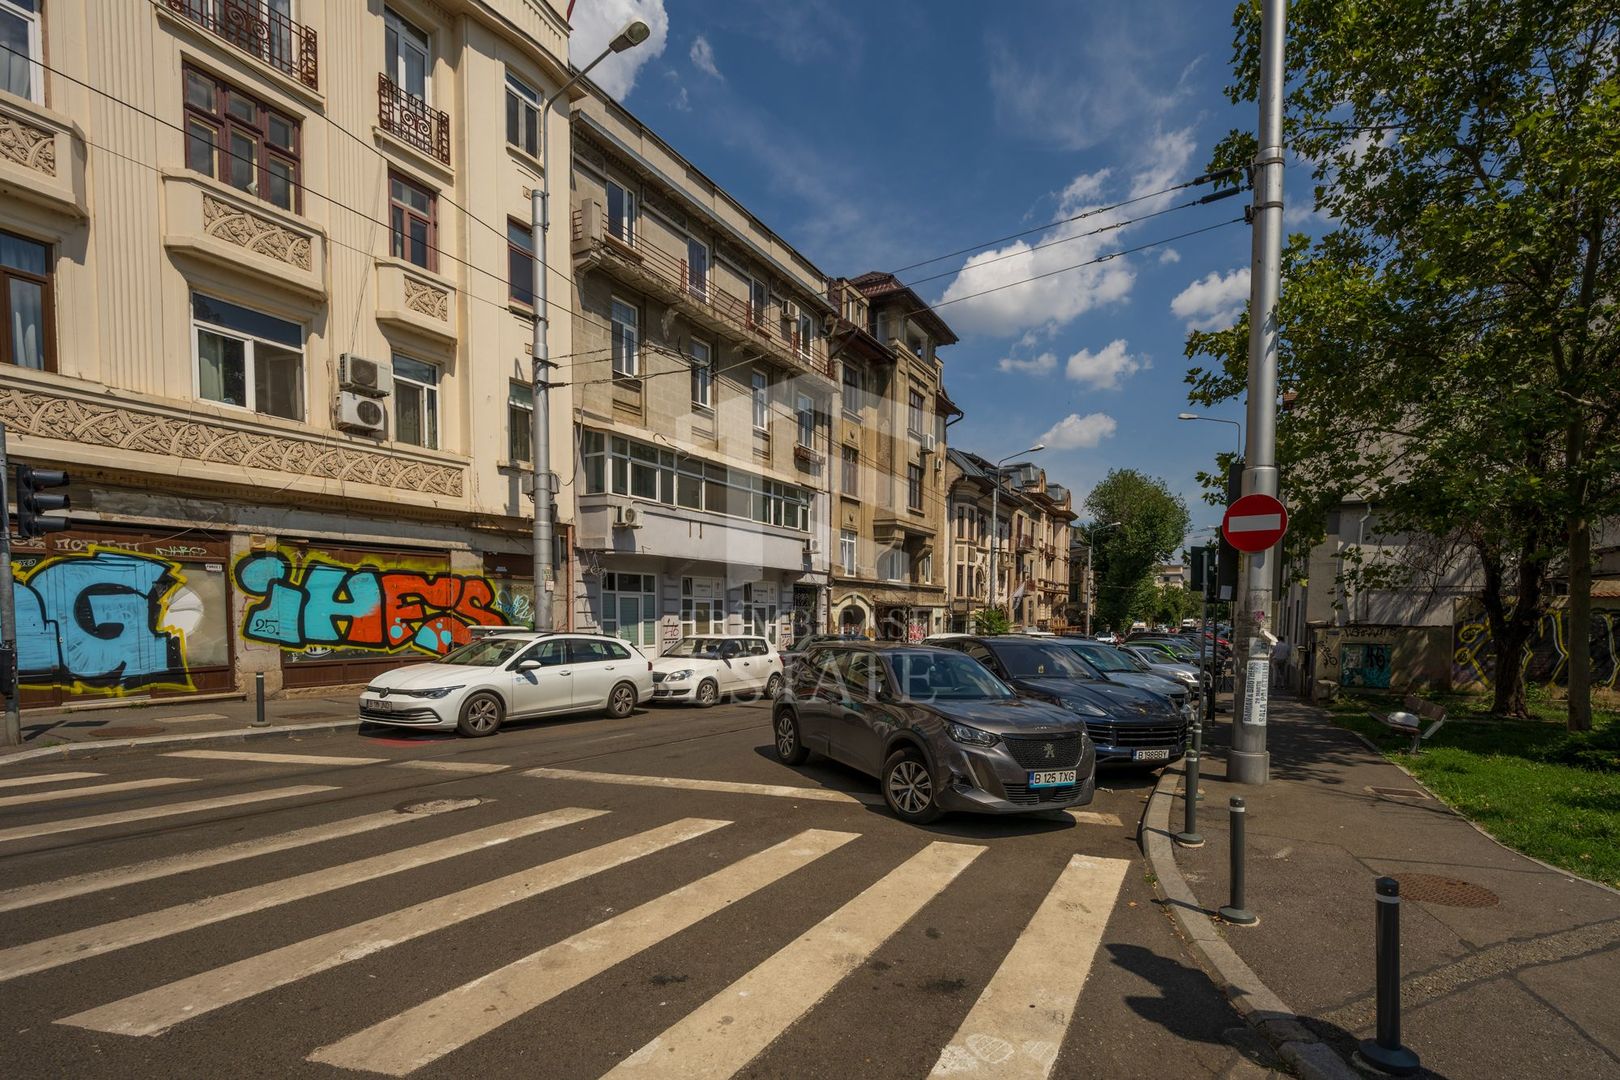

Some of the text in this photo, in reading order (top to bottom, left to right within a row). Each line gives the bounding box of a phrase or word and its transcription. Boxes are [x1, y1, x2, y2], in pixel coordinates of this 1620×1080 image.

[1034, 771, 1075, 784] B 125 TXG
